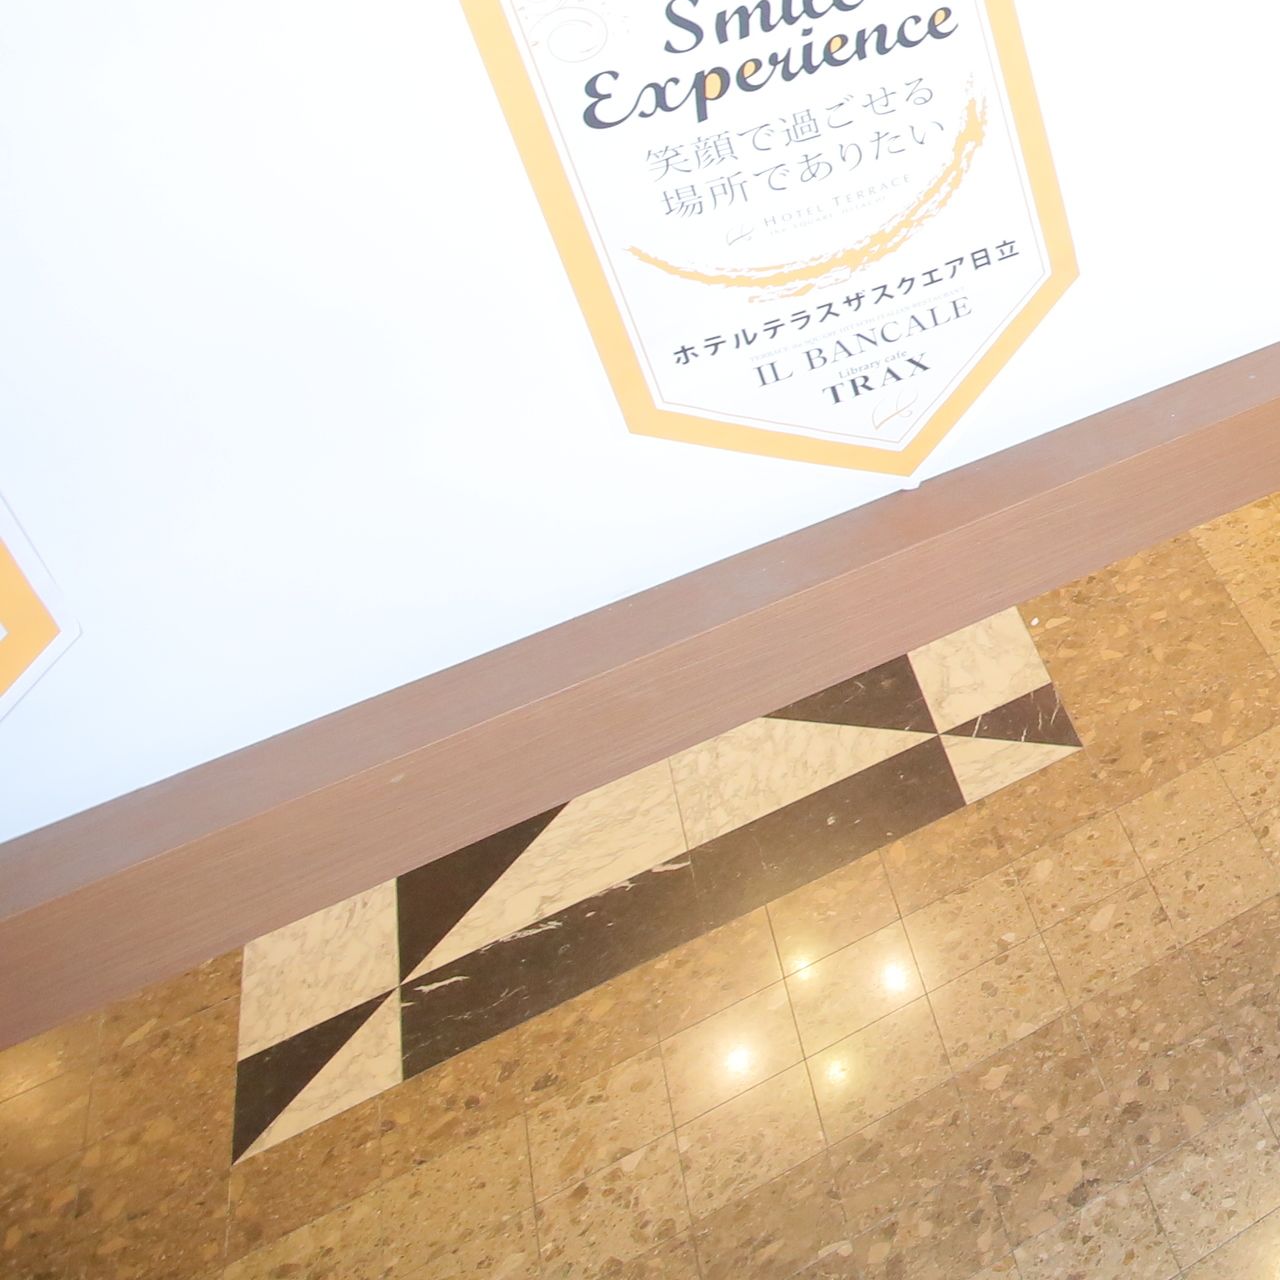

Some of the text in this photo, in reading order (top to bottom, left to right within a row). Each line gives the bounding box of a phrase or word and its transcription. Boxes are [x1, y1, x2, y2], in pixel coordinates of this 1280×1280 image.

[583, 6, 959, 129] Experience
[645, 77, 933, 182] 笑顔で過ごせる
[660, 121, 945, 218] 場所でありたい
[673, 239, 1020, 365] ホテルテラスザスクエア日立
[753, 296, 972, 387] IL BANCALE
[822, 353, 932, 405] TRAX
[838, 359, 881, 380] Library
